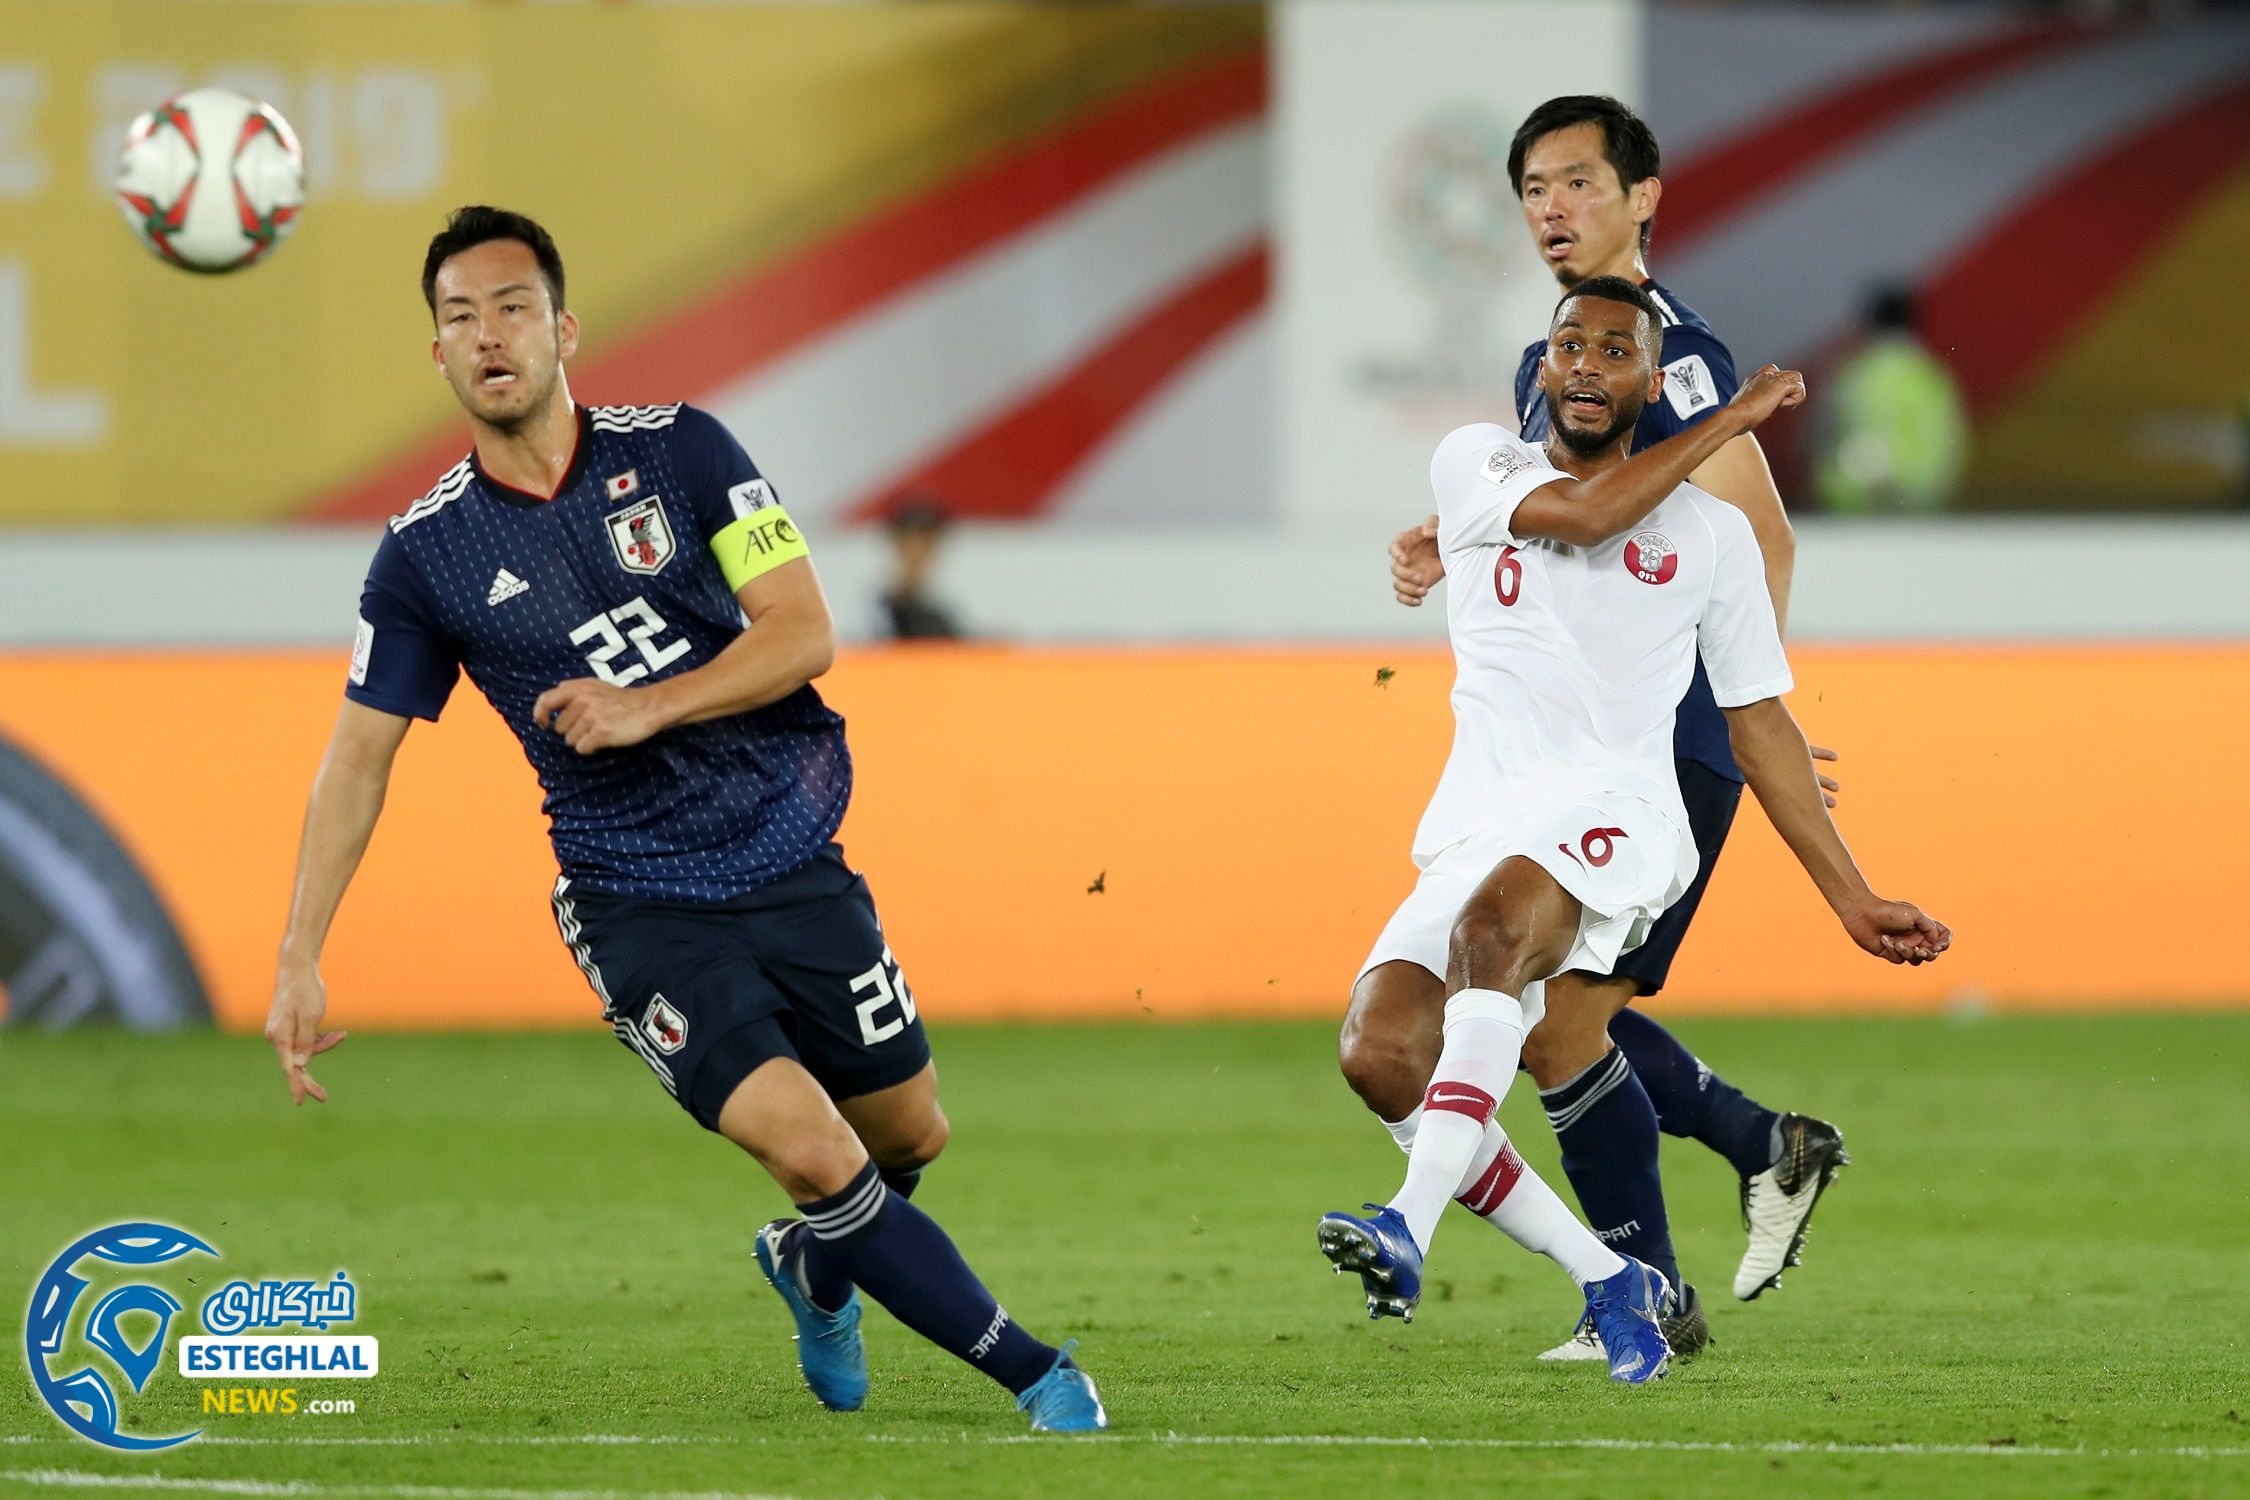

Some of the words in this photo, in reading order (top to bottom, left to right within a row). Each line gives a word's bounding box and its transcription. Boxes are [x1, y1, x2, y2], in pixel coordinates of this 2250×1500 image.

[744, 518, 798, 565] AFC
[1494, 546, 1522, 607] 6
[1638, 570, 1658, 582] QFA
[568, 595, 692, 688] 22
[1581, 827, 1629, 867] 6
